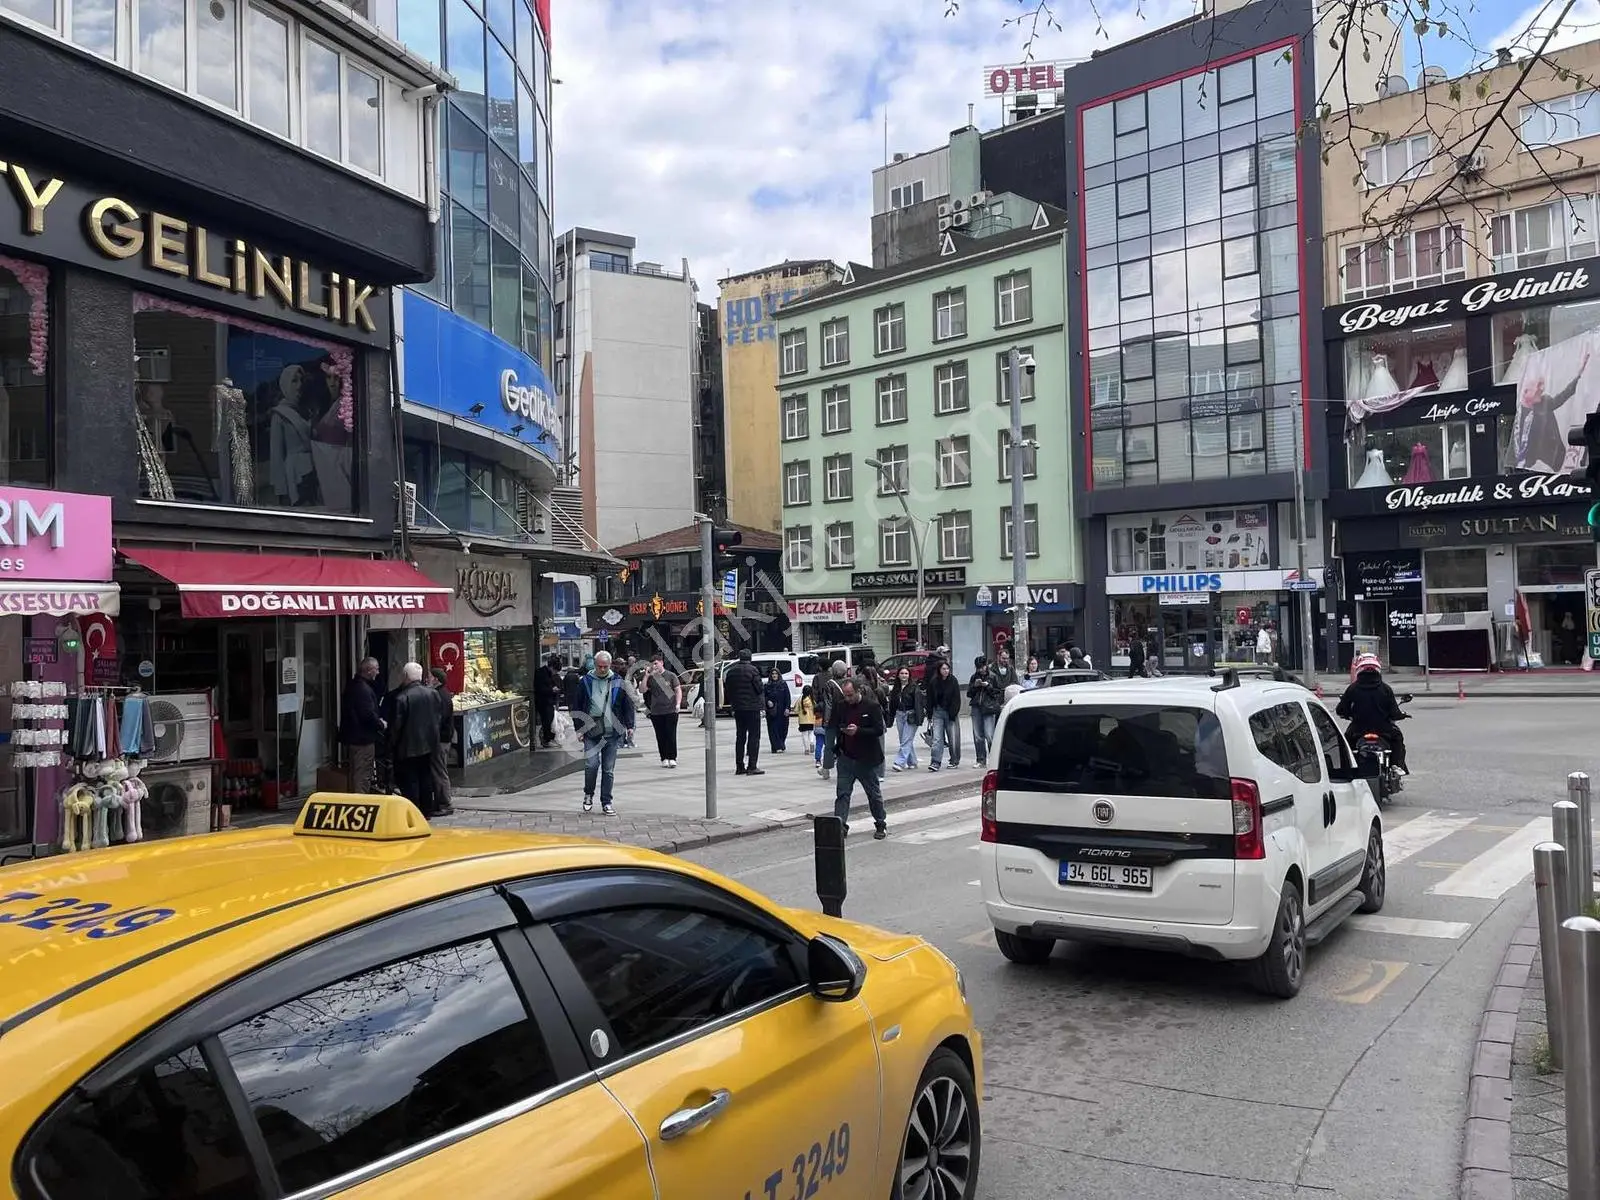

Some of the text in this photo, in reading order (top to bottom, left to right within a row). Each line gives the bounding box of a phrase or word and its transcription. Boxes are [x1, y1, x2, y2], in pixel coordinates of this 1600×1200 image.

[989, 65, 1063, 94] OTEL
[1339, 267, 1590, 333] Beyaz Gelinlik
[1385, 485, 1484, 510] Nişanlık
[1493, 483, 1513, 499] &
[1461, 514, 1557, 537] SULTAN
[1142, 574, 1222, 592] PHILIPS
[222, 592, 426, 611] DOĞANLI MARKET
[798, 602, 843, 614] ECZANE
[1069, 864, 1085, 879] 34
[1091, 865, 1115, 882] GGL
[1122, 868, 1148, 884] 965
[0, 898, 176, 939] 3249
[792, 1122, 850, 1200] 3249
